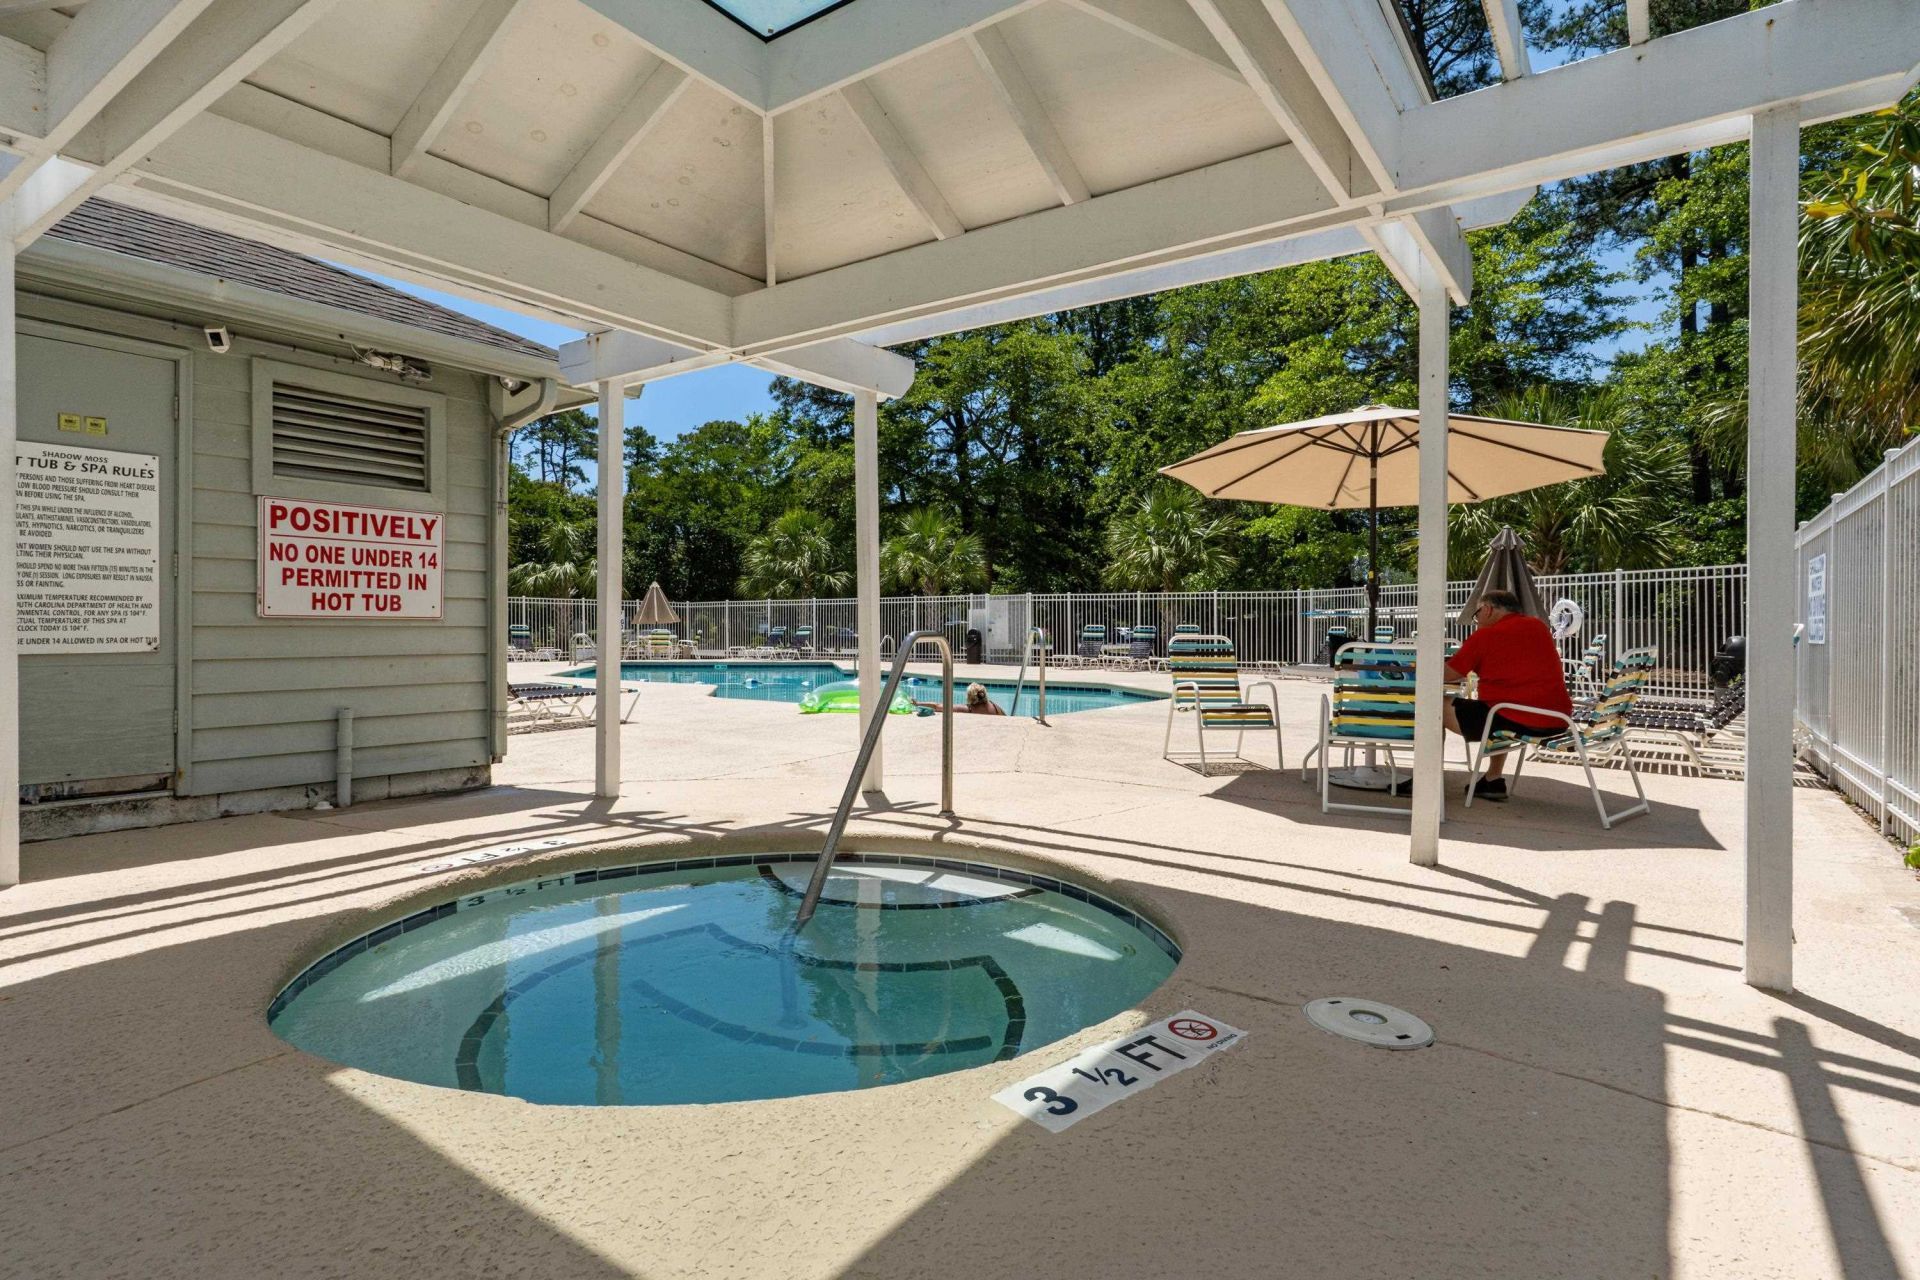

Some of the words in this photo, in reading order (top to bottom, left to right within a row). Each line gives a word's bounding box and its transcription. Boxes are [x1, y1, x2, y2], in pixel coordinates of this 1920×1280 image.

[42, 451, 82, 460] SHADOW
[27, 457, 58, 469] TUB
[64, 461, 76, 470] &
[81, 463, 107, 474] SPA
[113, 466, 154, 478] RULES
[19, 472, 44, 481] PERSONS
[58, 476, 75, 484] THOSE
[76, 478, 103, 486] SUFFERING
[52, 484, 77, 492] PRESSURE
[106, 526, 144, 535] TRANQUILIZERS
[270, 505, 438, 540] POSITIVELY
[270, 542, 299, 562] NO
[305, 544, 345, 564] ONE
[352, 548, 413, 568] UNDER
[418, 552, 438, 569] 14
[282, 568, 401, 590] PERMITTED
[408, 574, 427, 590] IN
[312, 592, 355, 611] HOT
[362, 593, 402, 612] TUB
[468, 896, 486, 906] 3
[538, 876, 570, 890] FT
[1216, 1034, 1238, 1045] DIVING
[1024, 1086, 1078, 1115] 3
[1115, 1035, 1187, 1071] FT
